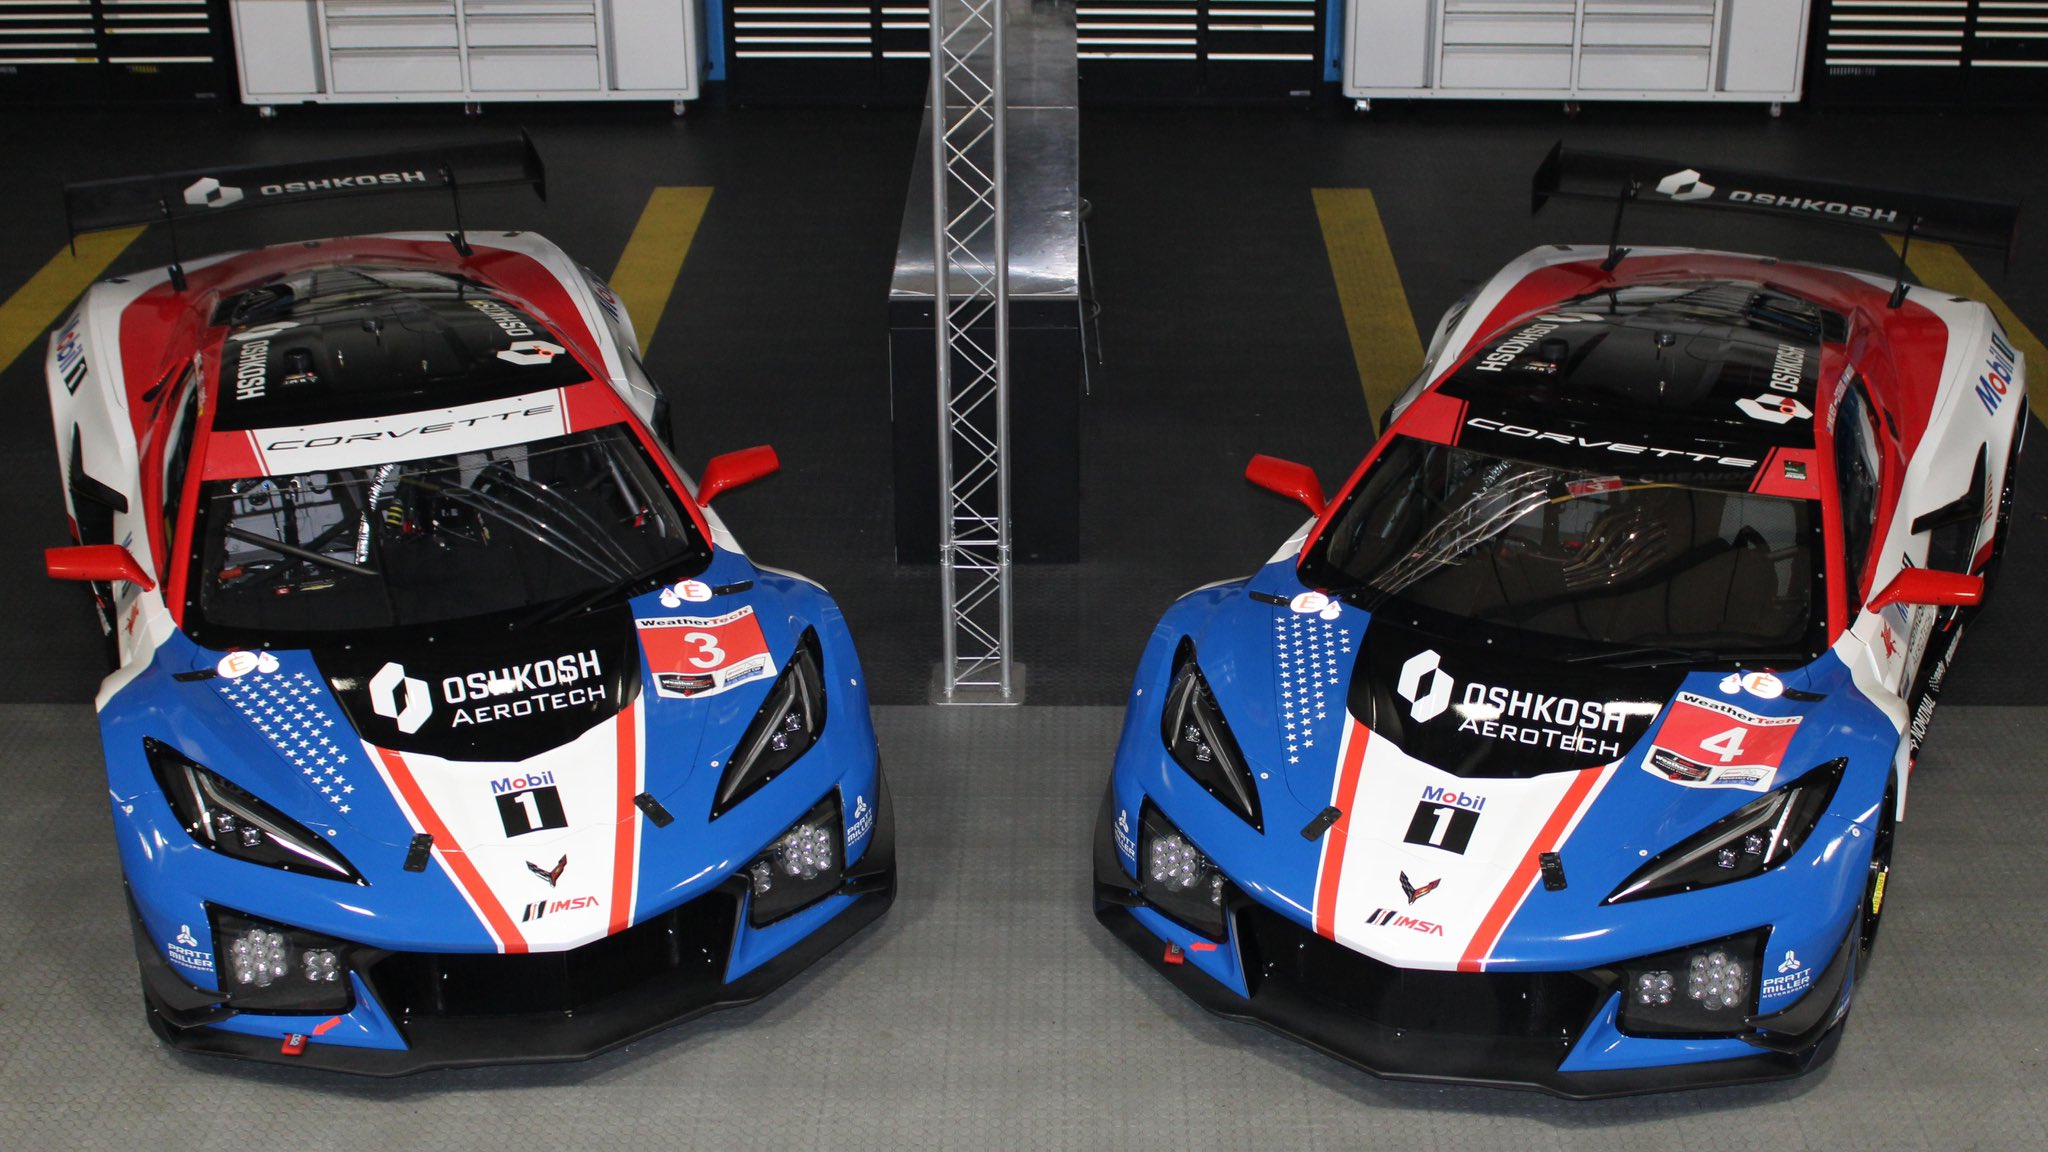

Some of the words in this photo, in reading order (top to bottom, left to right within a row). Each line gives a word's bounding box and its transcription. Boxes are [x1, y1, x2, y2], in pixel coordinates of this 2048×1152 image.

[260, 171, 426, 196] OSHKOSH
[1729, 190, 1897, 222] OSHKOSH
[1476, 323, 1559, 372] OSHKOSH
[236, 340, 269, 400] OSHKOSH
[1769, 343, 1806, 392] OSHKOSH
[1975, 345, 2014, 416] Mobil
[266, 404, 555, 451] CORVETTE
[1466, 417, 1758, 467] CORVETTE
[683, 584, 704, 598] E
[641, 607, 749, 627] WeatherTech
[228, 655, 249, 674] E
[684, 632, 726, 669] 3
[442, 649, 602, 704] OSHKOSH
[1751, 676, 1774, 692] E
[1683, 694, 1800, 725] WeatherTech
[1911, 693, 1936, 743] NOMINAL
[1699, 726, 1748, 762] 4
[491, 771, 555, 794] Mobil
[1421, 785, 1486, 811] Mobil
[514, 791, 543, 829] 1
[1429, 807, 1455, 847] 1
[550, 896, 599, 913] IMSA
[1393, 916, 1443, 936] IMSA
[168, 943, 211, 959] PRATT
[169, 950, 213, 967] MILLER
[1763, 967, 1811, 987] PRATT
[1763, 977, 1810, 994] MILLER
